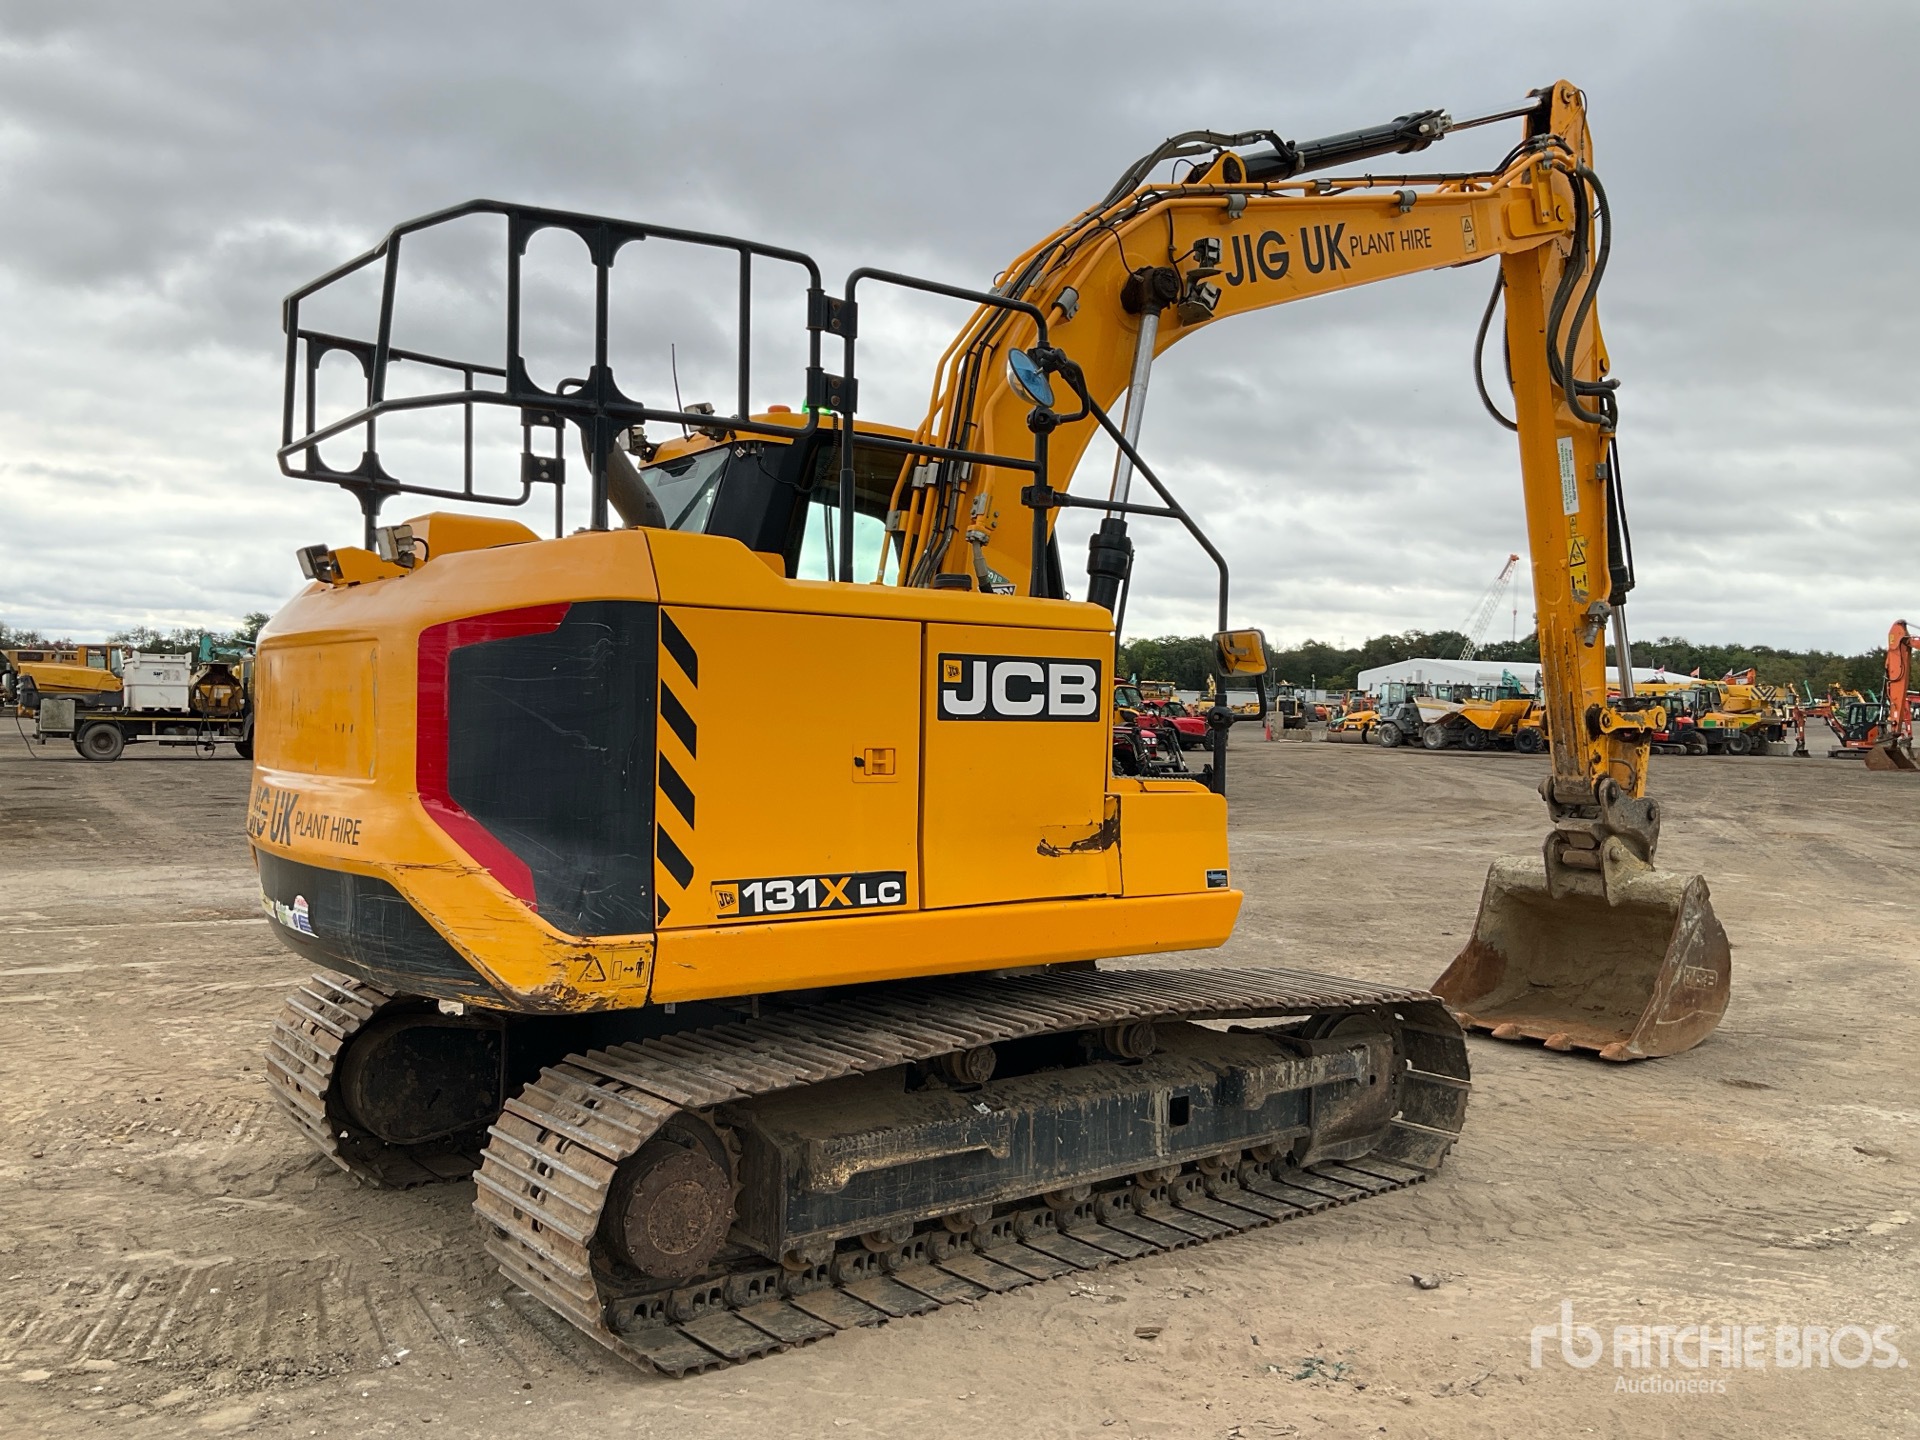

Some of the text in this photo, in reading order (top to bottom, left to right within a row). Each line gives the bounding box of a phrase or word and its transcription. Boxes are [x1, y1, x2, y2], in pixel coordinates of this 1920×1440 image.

[1226, 222, 1433, 287] JIG UK PLANT HIRE
[942, 661, 1098, 717] JCB
[270, 790, 300, 847] UK
[294, 810, 329, 840] PLANT
[330, 816, 362, 846] HIRE
[716, 876, 901, 913] JCB 131X LC
